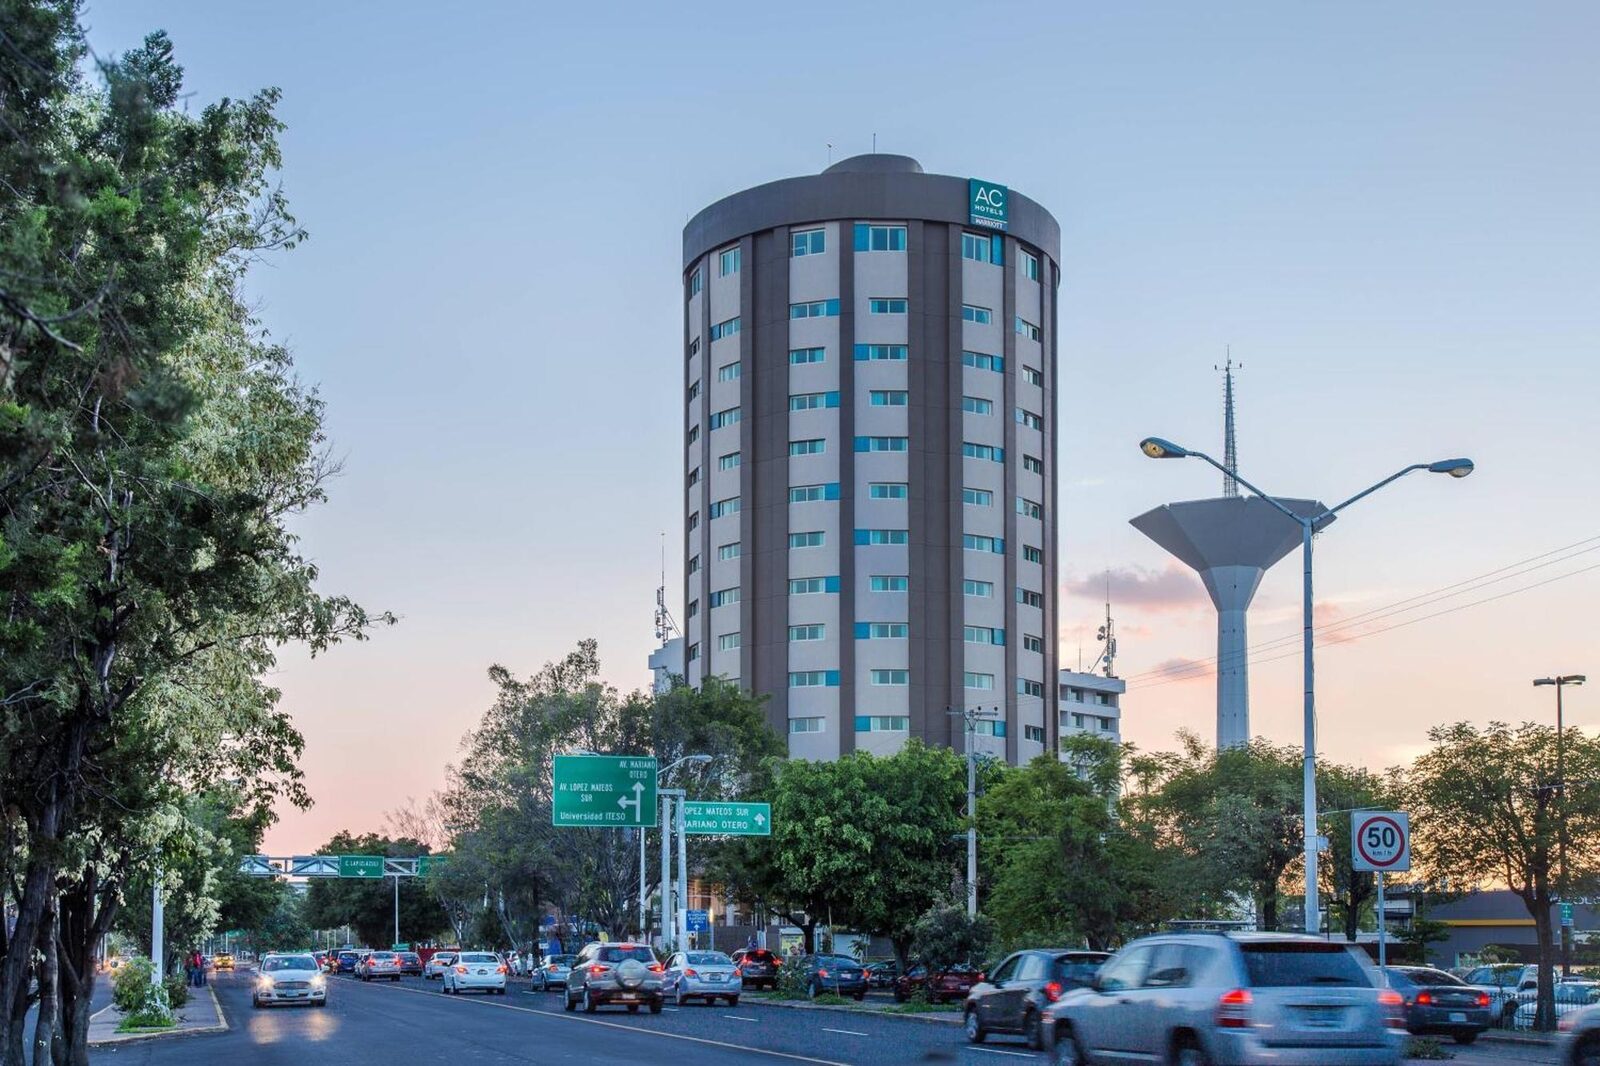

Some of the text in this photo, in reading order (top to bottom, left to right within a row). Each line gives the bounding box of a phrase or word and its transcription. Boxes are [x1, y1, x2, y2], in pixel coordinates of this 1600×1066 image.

[975, 186, 1003, 207] AC
[974, 205, 1003, 216] HOTELS
[630, 761, 656, 770] MARIANO
[629, 770, 648, 779] OTERO
[570, 782, 588, 792] LOPEZ
[590, 783, 613, 792] MATEOS
[580, 793, 593, 802] SUR
[560, 811, 626, 821] Universidad ITESO
[684, 806, 749, 816] OPEZ MATEOS SUR
[721, 821, 748, 829] OTERO
[1367, 826, 1395, 848] 50
